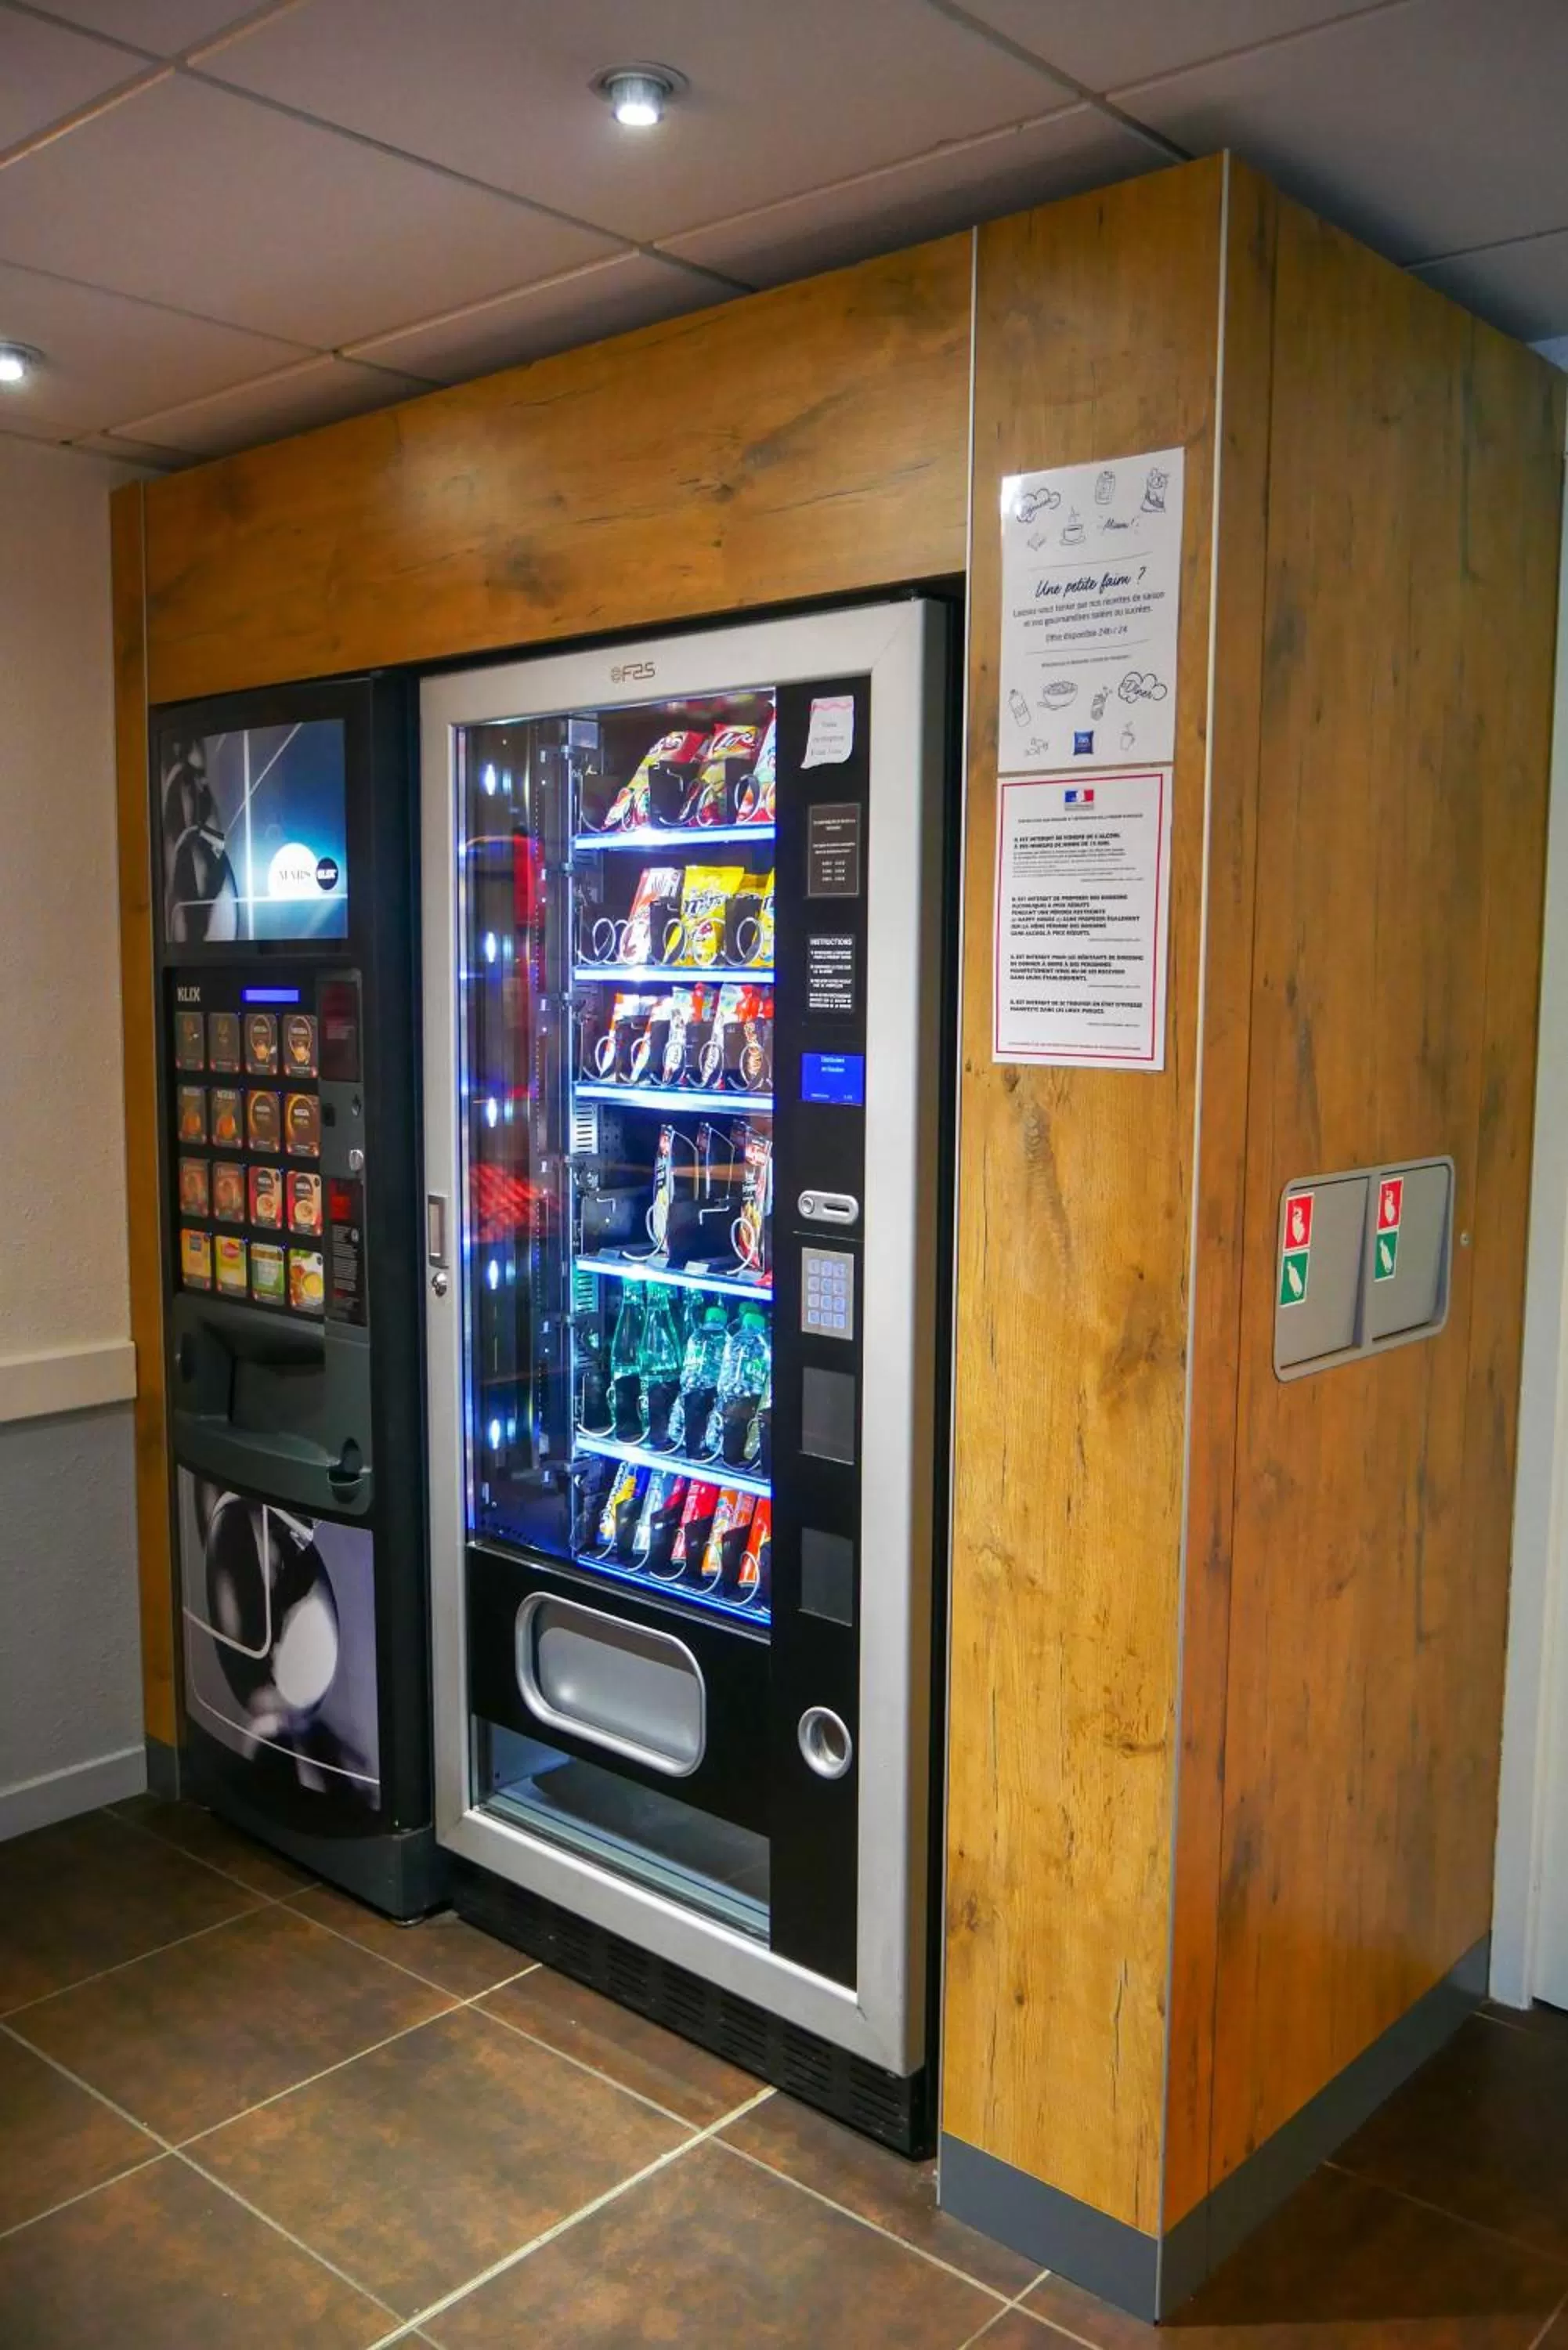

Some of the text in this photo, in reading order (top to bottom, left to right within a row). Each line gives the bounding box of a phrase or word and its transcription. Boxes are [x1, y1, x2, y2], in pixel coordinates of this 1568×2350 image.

[1035, 579, 1062, 598] Une
[1063, 576, 1097, 598] petite
[1099, 571, 1131, 595] faim
[176, 986, 201, 1002] KLIX
